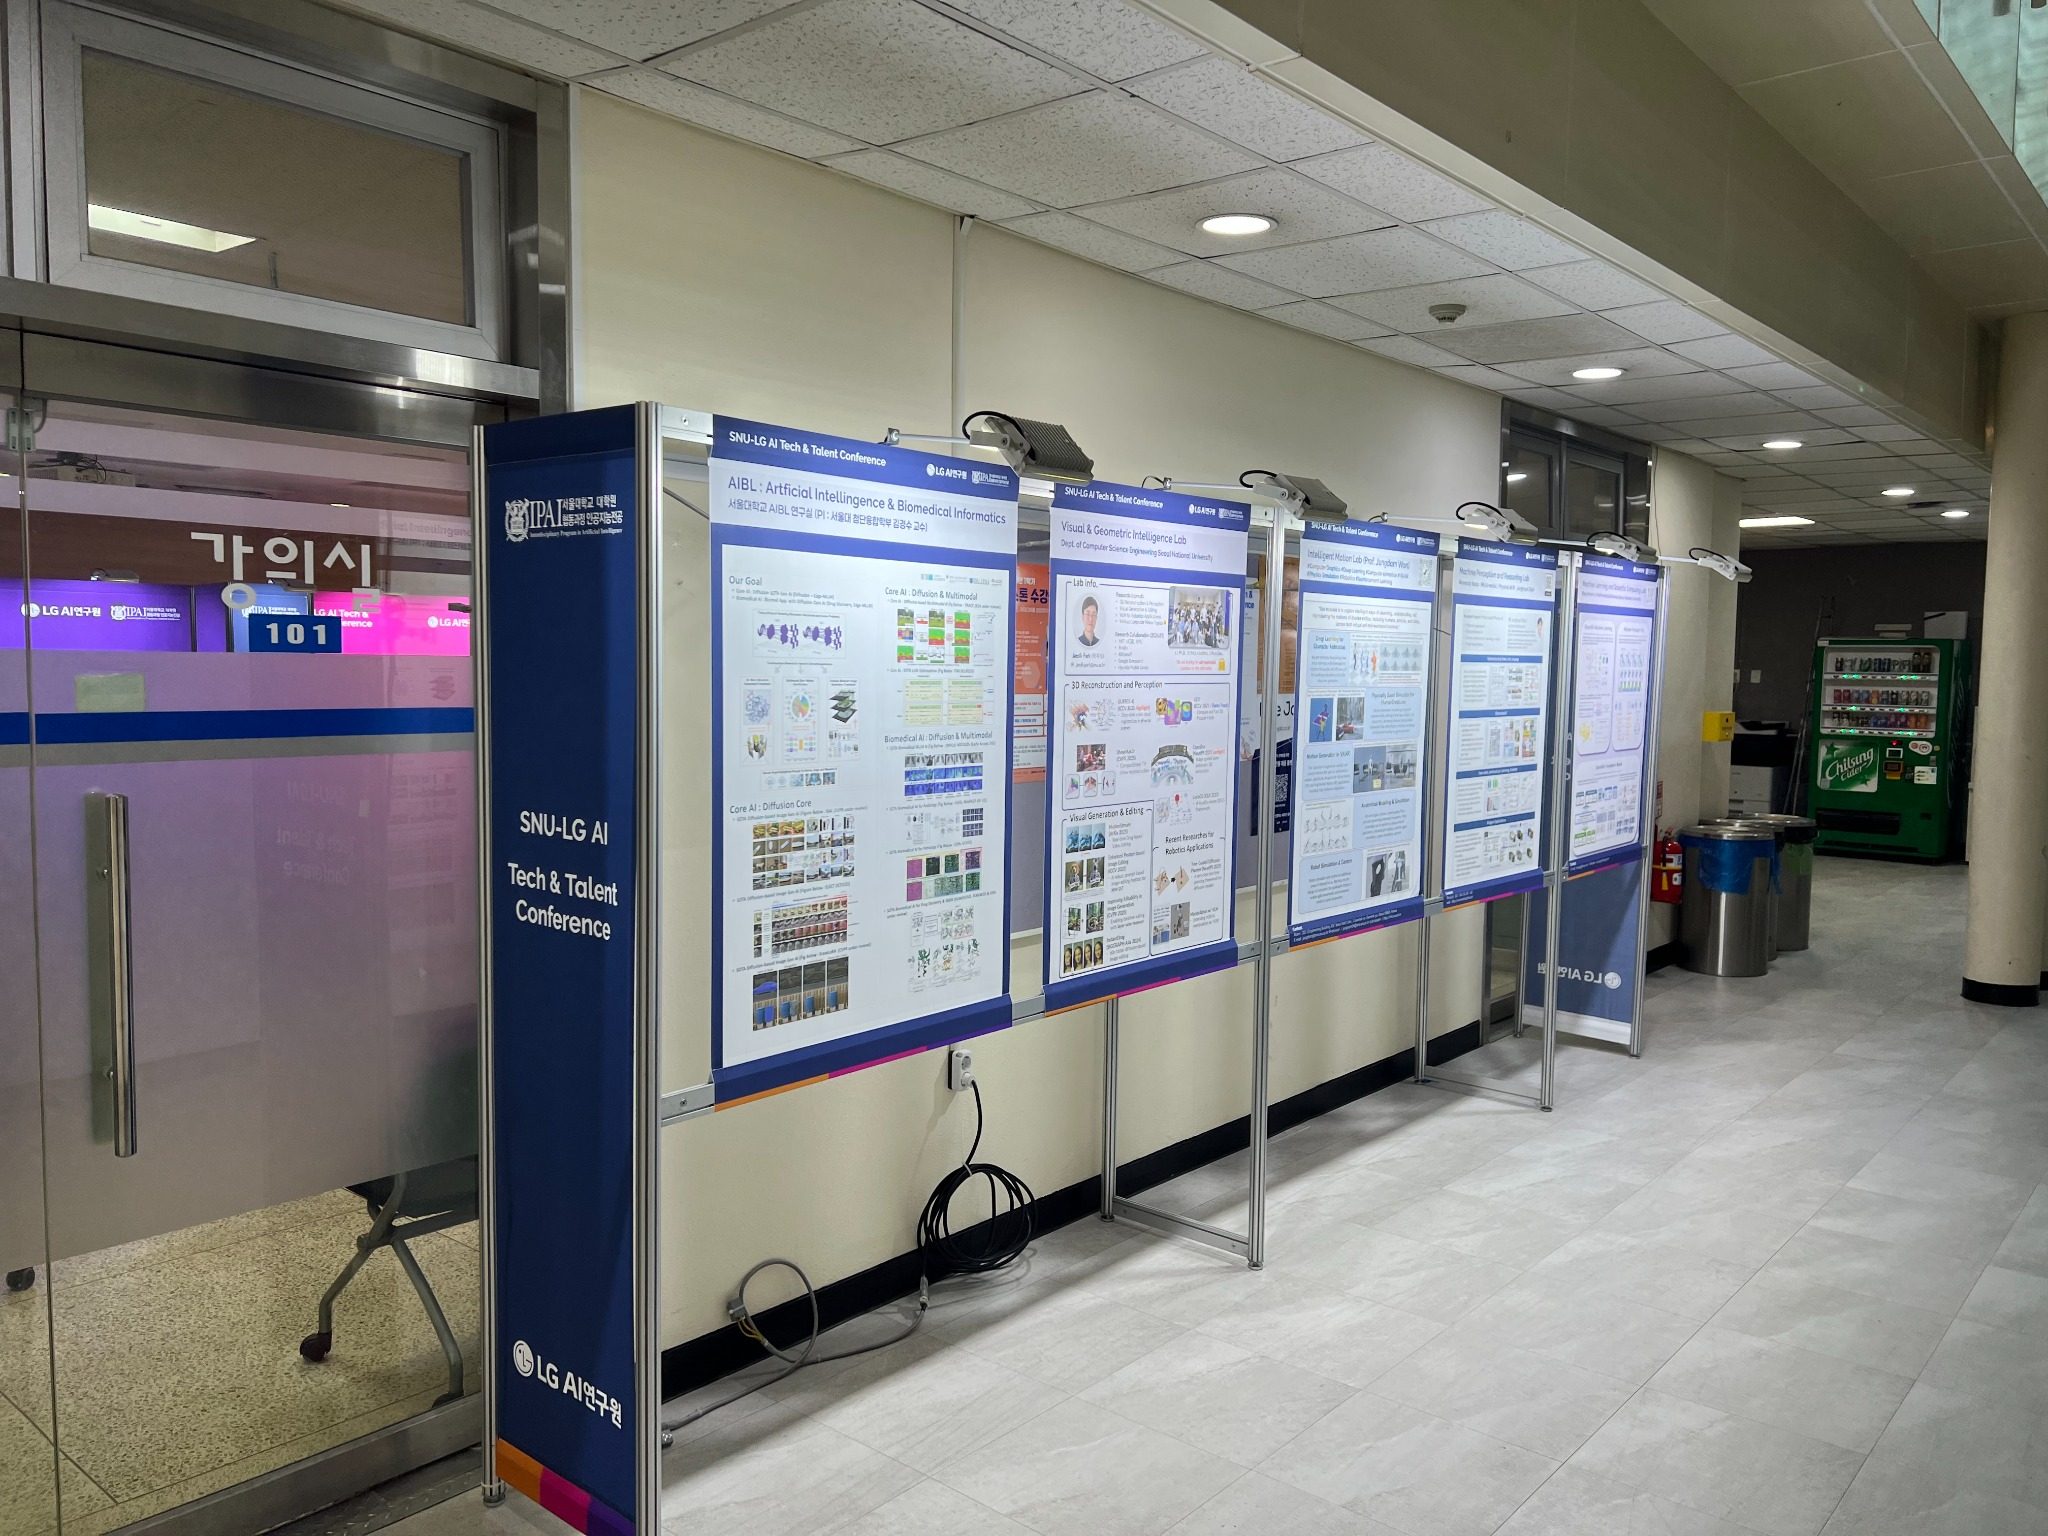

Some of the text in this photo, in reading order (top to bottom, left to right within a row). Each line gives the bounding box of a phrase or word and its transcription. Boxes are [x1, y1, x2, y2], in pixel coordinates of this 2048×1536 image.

[729, 430, 887, 467] SNU-LG AI Tech & Talent Conference
[728, 476, 757, 492] AIBL
[765, 481, 814, 499] Artficial
[815, 484, 885, 510] Intellingence
[887, 499, 895, 510] &
[897, 499, 953, 518] Biomedical
[954, 507, 1006, 524] Informatics
[1065, 486, 1088, 498] SNU-LG
[1096, 491, 1109, 501] Tech
[1115, 494, 1133, 504] Talent
[1133, 497, 1163, 509] Conference
[530, 499, 563, 528] IPAI
[769, 504, 790, 516] AIBL
[790, 506, 813, 520] 연구실
[830, 510, 852, 524] 서울대
[1061, 521, 1187, 545] Visual & Geometric Intelligence Lab
[190, 531, 382, 614] 강의실
[729, 575, 762, 586] Our Goal
[1073, 578, 1084, 587] Lab
[42, 605, 59, 616] LG
[266, 622, 327, 645] 101
[1081, 681, 1122, 690] Reconstruction
[1134, 681, 1163, 691] Perception
[884, 733, 918, 743] Biomedical
[729, 804, 747, 814] Core
[749, 803, 757, 813] AI
[763, 800, 795, 811] Diffusion
[796, 799, 812, 808] Core
[1069, 813, 1087, 823] Visual
[1087, 810, 1119, 820] Generation
[520, 810, 608, 846] SNU-LG AI
[507, 862, 619, 906] Tech & Talent
[515, 899, 612, 941] Conference
[537, 1355, 622, 1429] LG AI연구원
